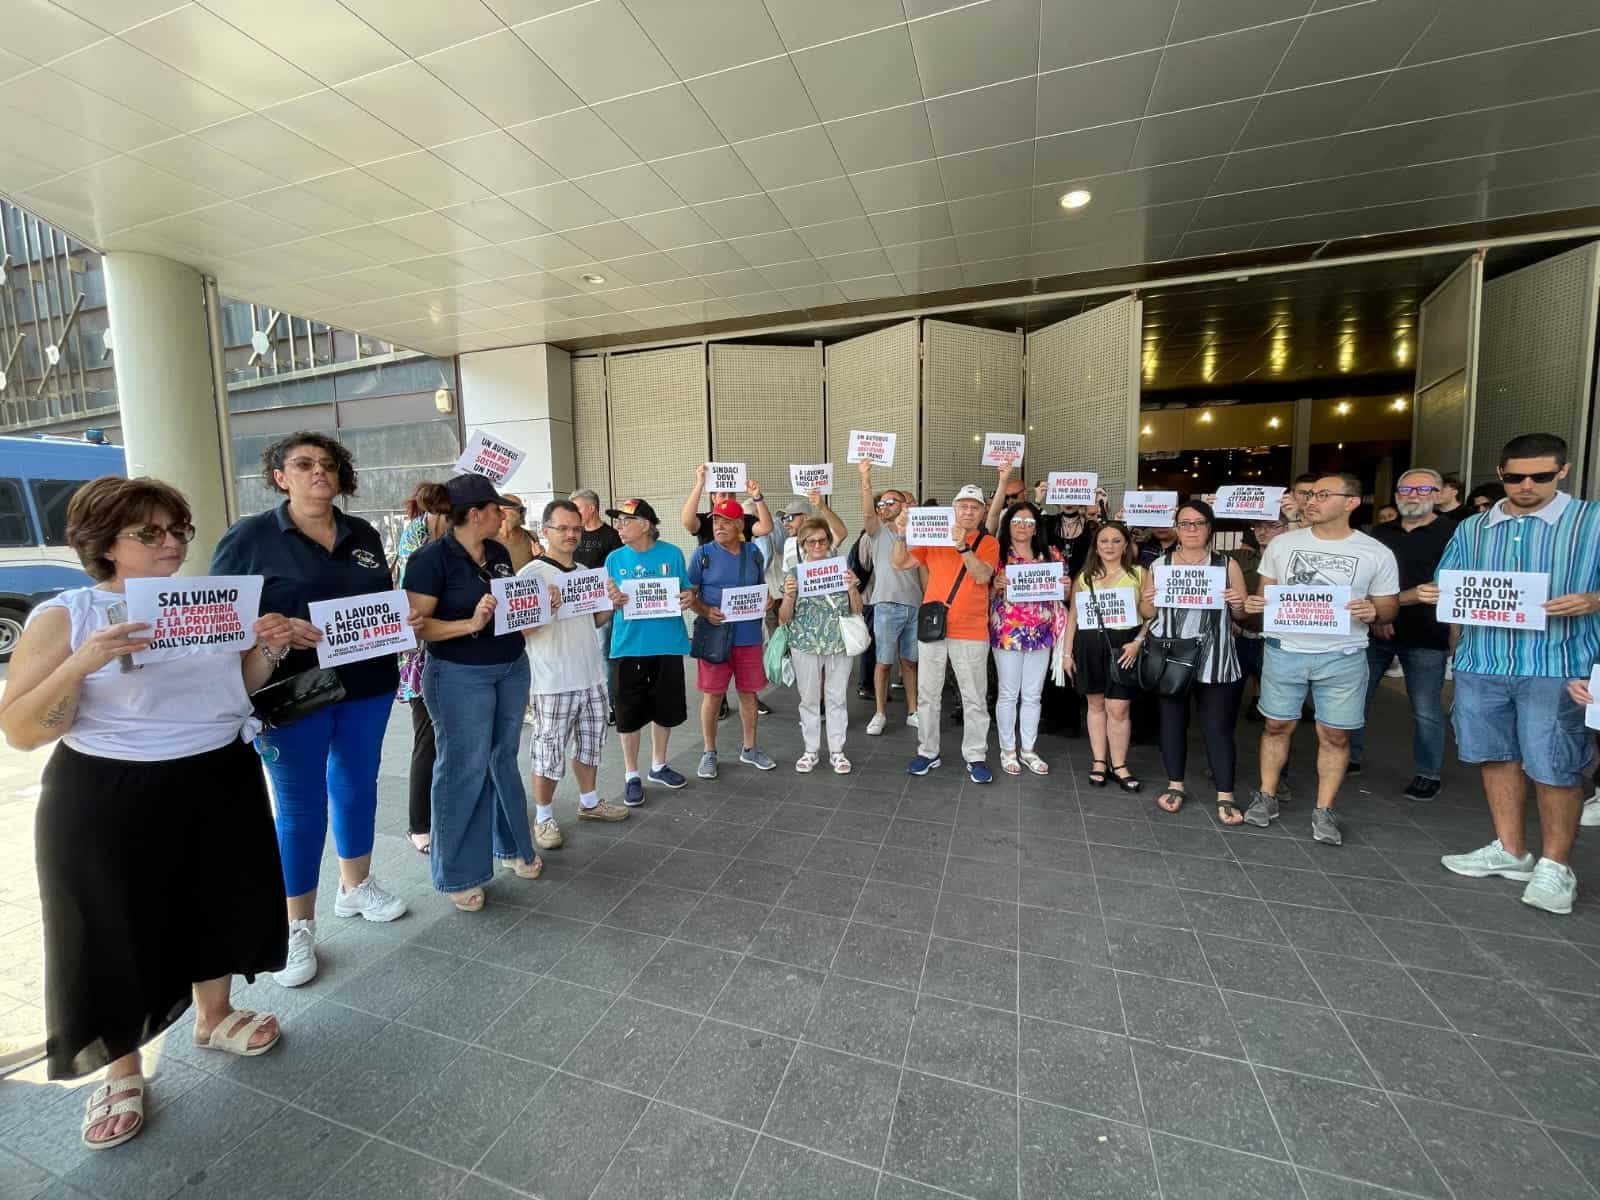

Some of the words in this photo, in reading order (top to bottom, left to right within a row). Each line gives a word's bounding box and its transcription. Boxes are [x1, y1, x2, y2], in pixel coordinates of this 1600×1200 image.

[1056, 478, 1088, 487] NEGATO
[806, 564, 839, 578] NEGATO
[1172, 570, 1181, 578] IO
[1185, 570, 1205, 578] NON
[822, 574, 842, 583] DIRITTO
[1167, 578, 1191, 586] SONO
[1463, 576, 1476, 586] IO
[1482, 578, 1512, 588] NON
[158, 589, 239, 607] SALVIAMO
[1177, 596, 1203, 604] SERIE
[1280, 593, 1333, 602] SALVIAMO
[1454, 587, 1492, 599] SONO
[164, 607, 177, 617] LA
[182, 603, 234, 616] PERIFERIA
[509, 595, 539, 612] SENZA
[335, 611, 342, 622] A
[346, 603, 389, 620] LAVORO
[1452, 608, 1465, 618] DI
[1471, 610, 1510, 622] SERIE
[1516, 612, 1526, 623] B
[157, 618, 164, 628] E
[168, 617, 180, 627] LA
[185, 612, 238, 626] PROVINCIA
[337, 616, 378, 633] MEGLIO
[382, 612, 400, 624] CHE
[1274, 619, 1338, 627] DALL'ISOLAMENTO
[155, 629, 166, 639] DI
[170, 626, 213, 637] NAPOLI
[216, 622, 241, 633] NORD
[327, 631, 359, 646] VADO
[363, 630, 370, 639] A
[374, 623, 401, 636] PIEDI
